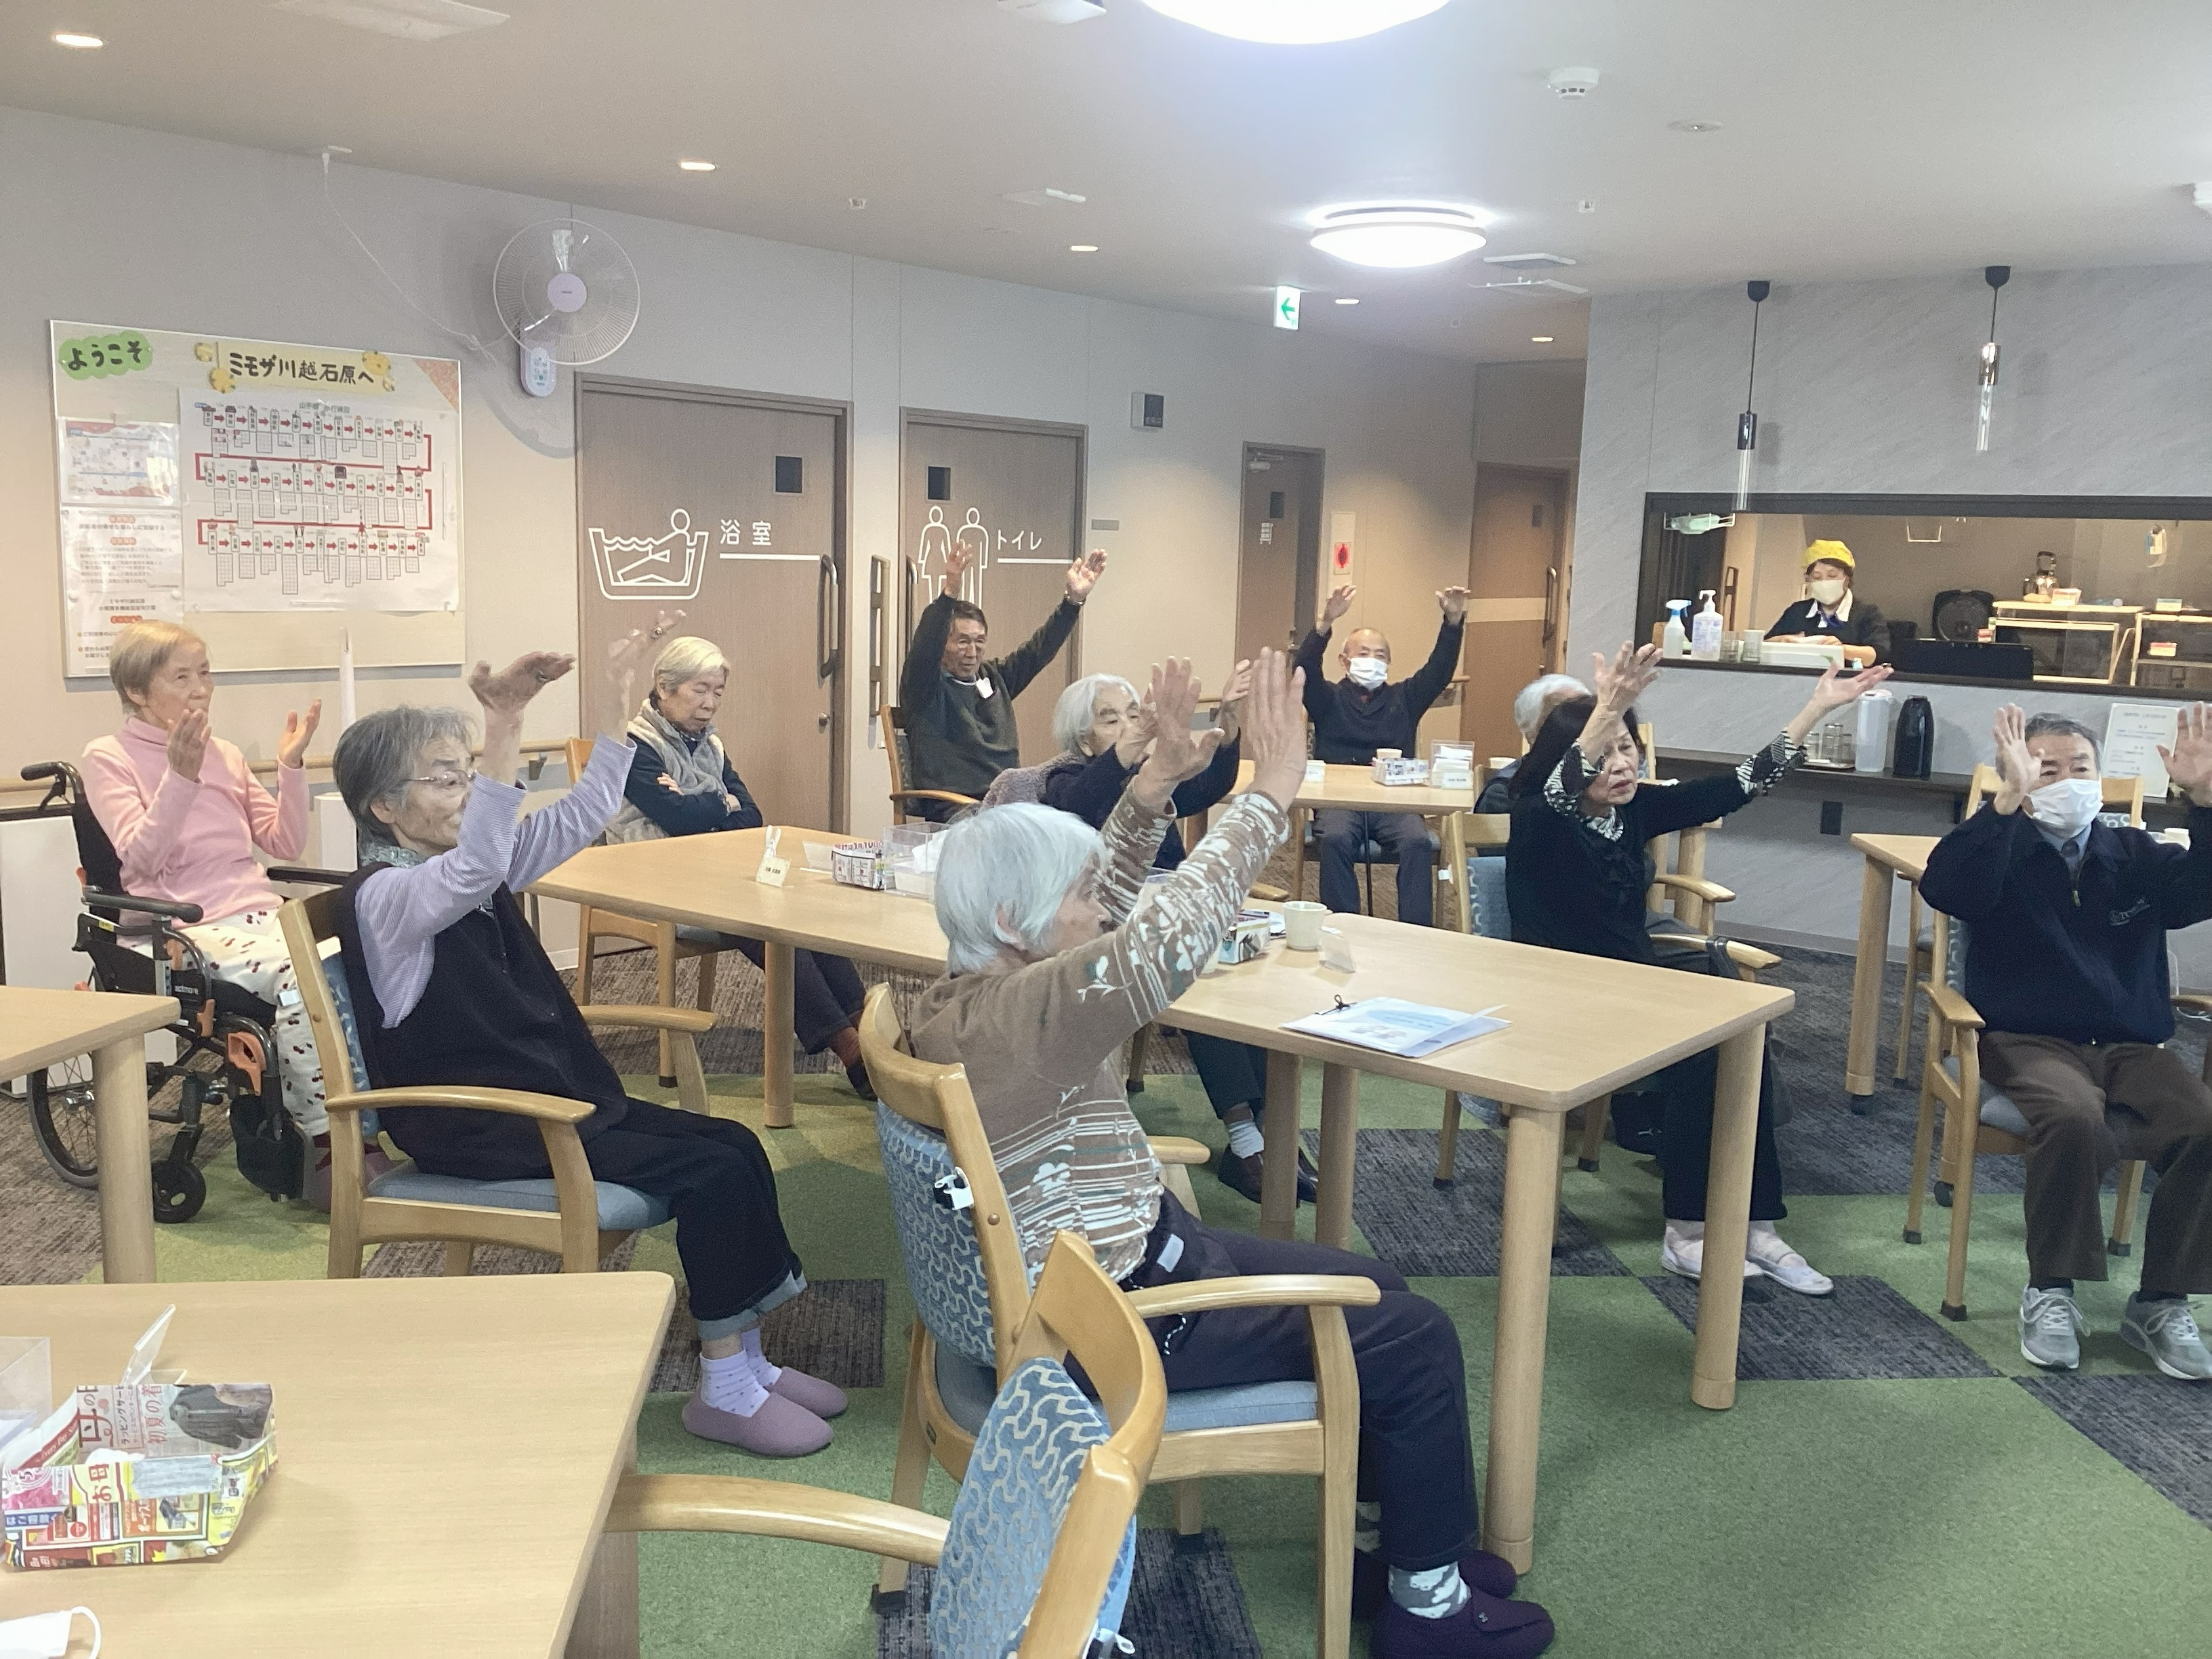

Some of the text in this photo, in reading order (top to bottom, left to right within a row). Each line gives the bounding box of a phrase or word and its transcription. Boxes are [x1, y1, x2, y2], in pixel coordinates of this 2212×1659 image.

[67, 340, 143, 371] ようこそ
[229, 352, 374, 385] ミモザ川越石原へ
[720, 518, 772, 546] 浴室
[998, 529, 1042, 550] トイレ
